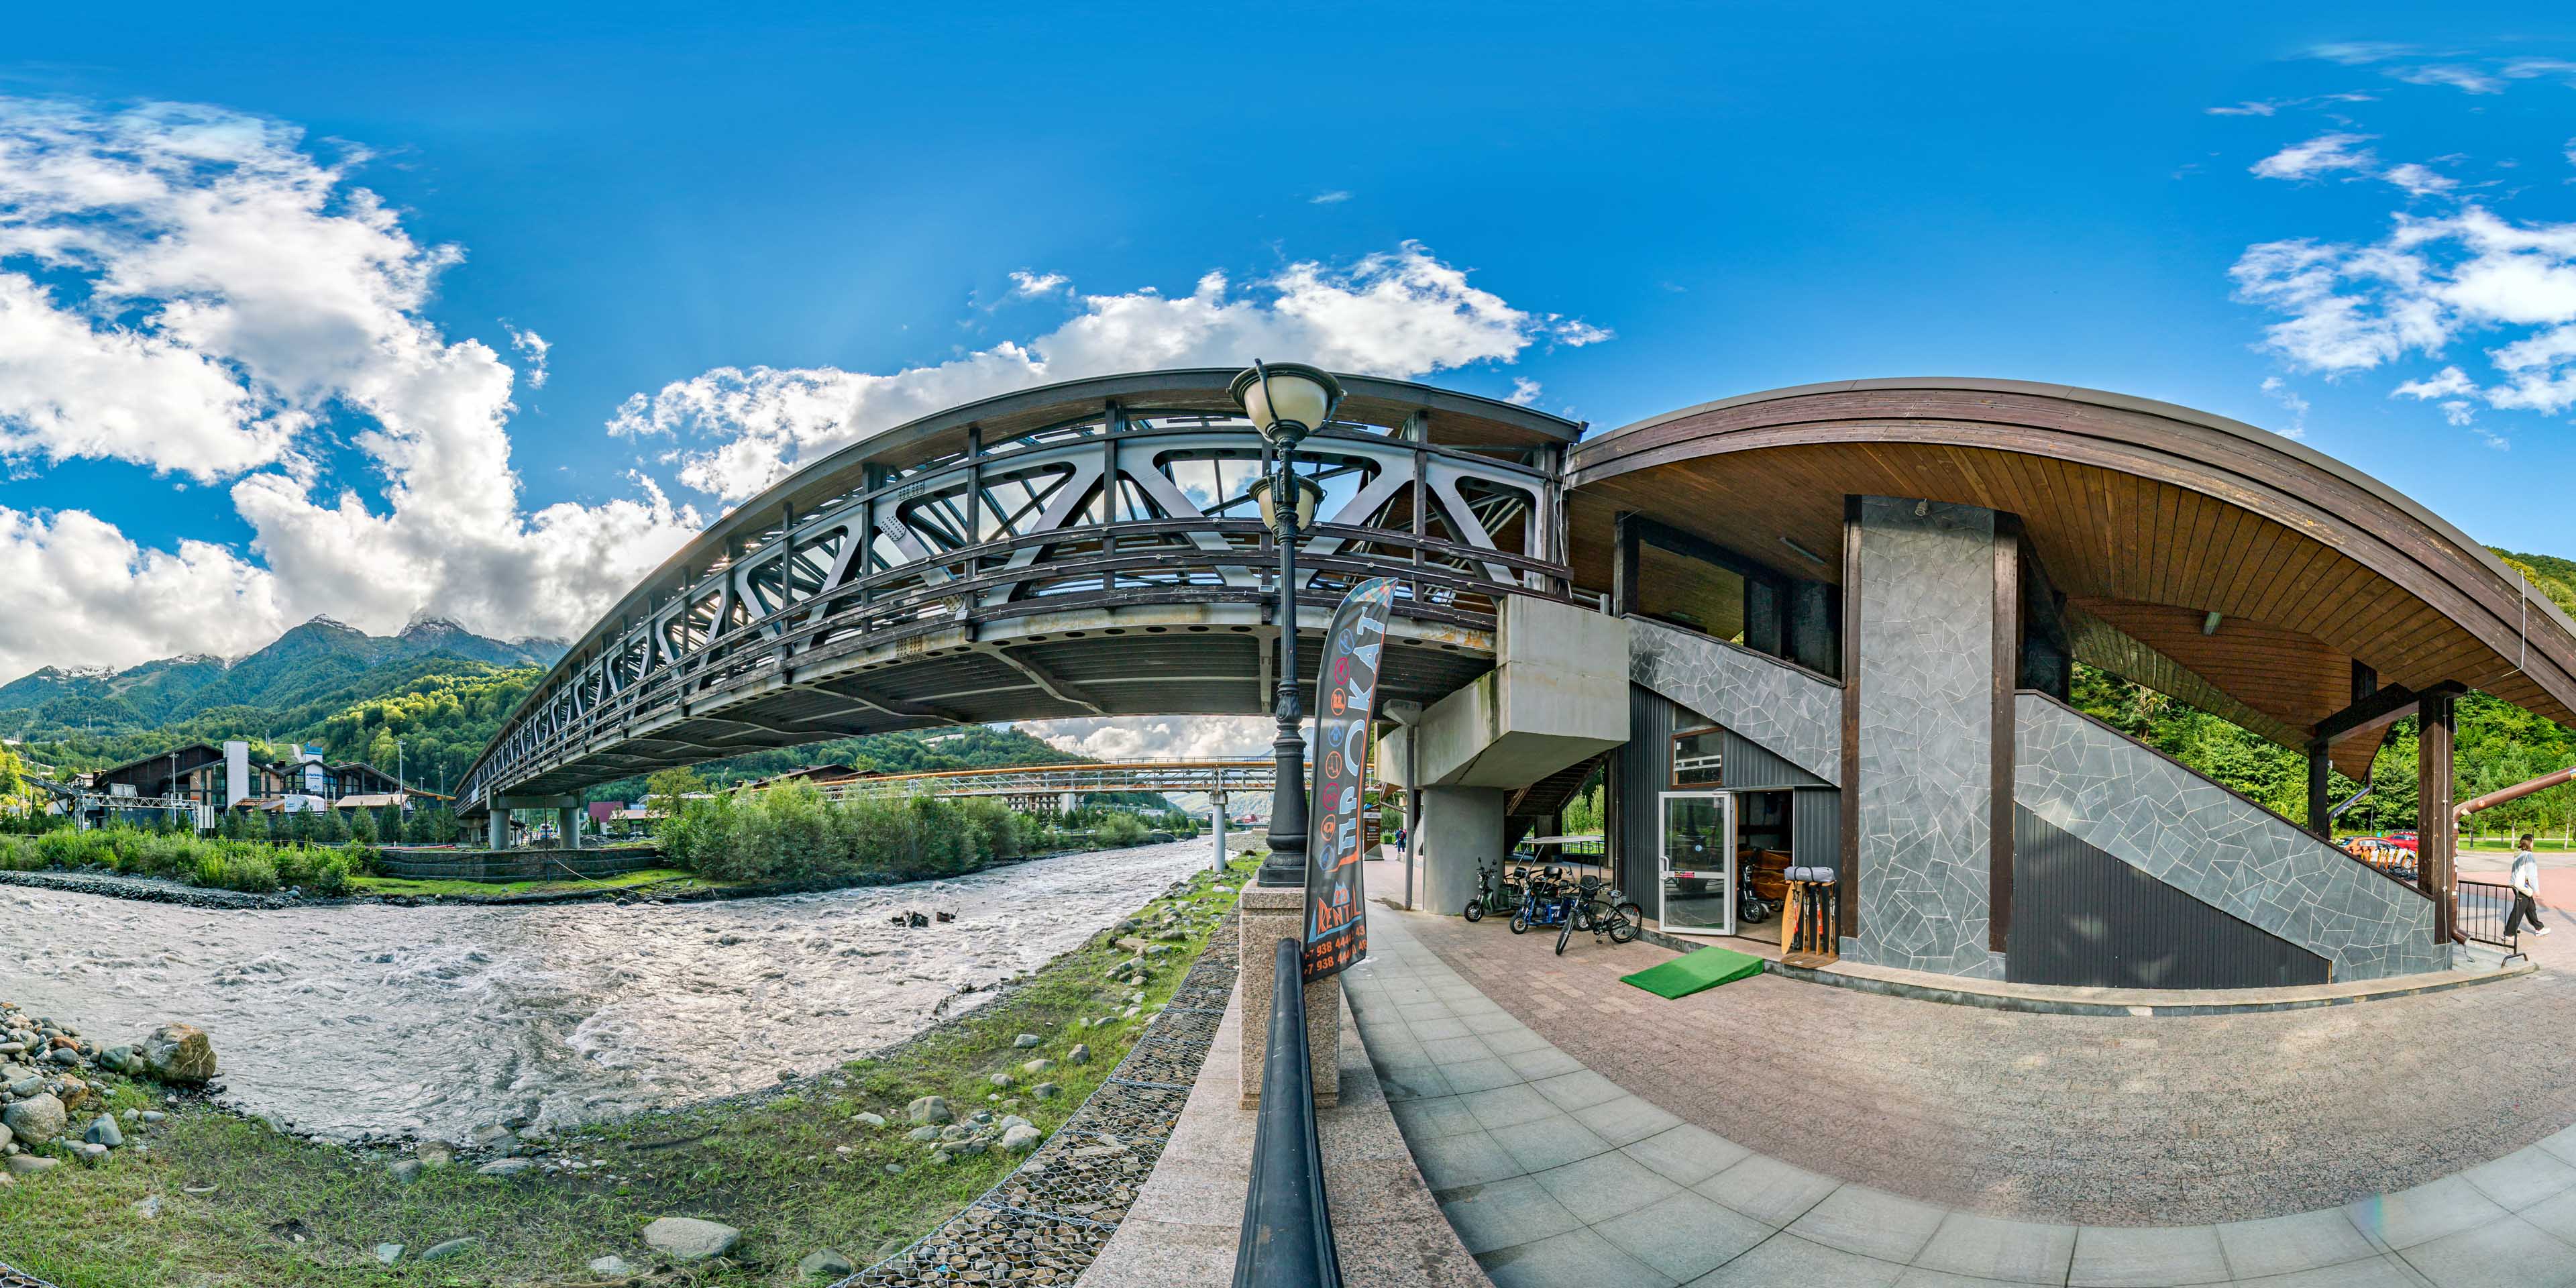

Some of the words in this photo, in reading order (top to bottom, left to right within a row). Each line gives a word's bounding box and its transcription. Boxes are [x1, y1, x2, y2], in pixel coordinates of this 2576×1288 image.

[1338, 606, 1385, 855] ПРОКАТ
[1335, 890, 1348, 904] 23
[1318, 884, 1361, 934] RENTAL
[1316, 941, 1332, 957] 938
[1316, 956, 1334, 971] 938
